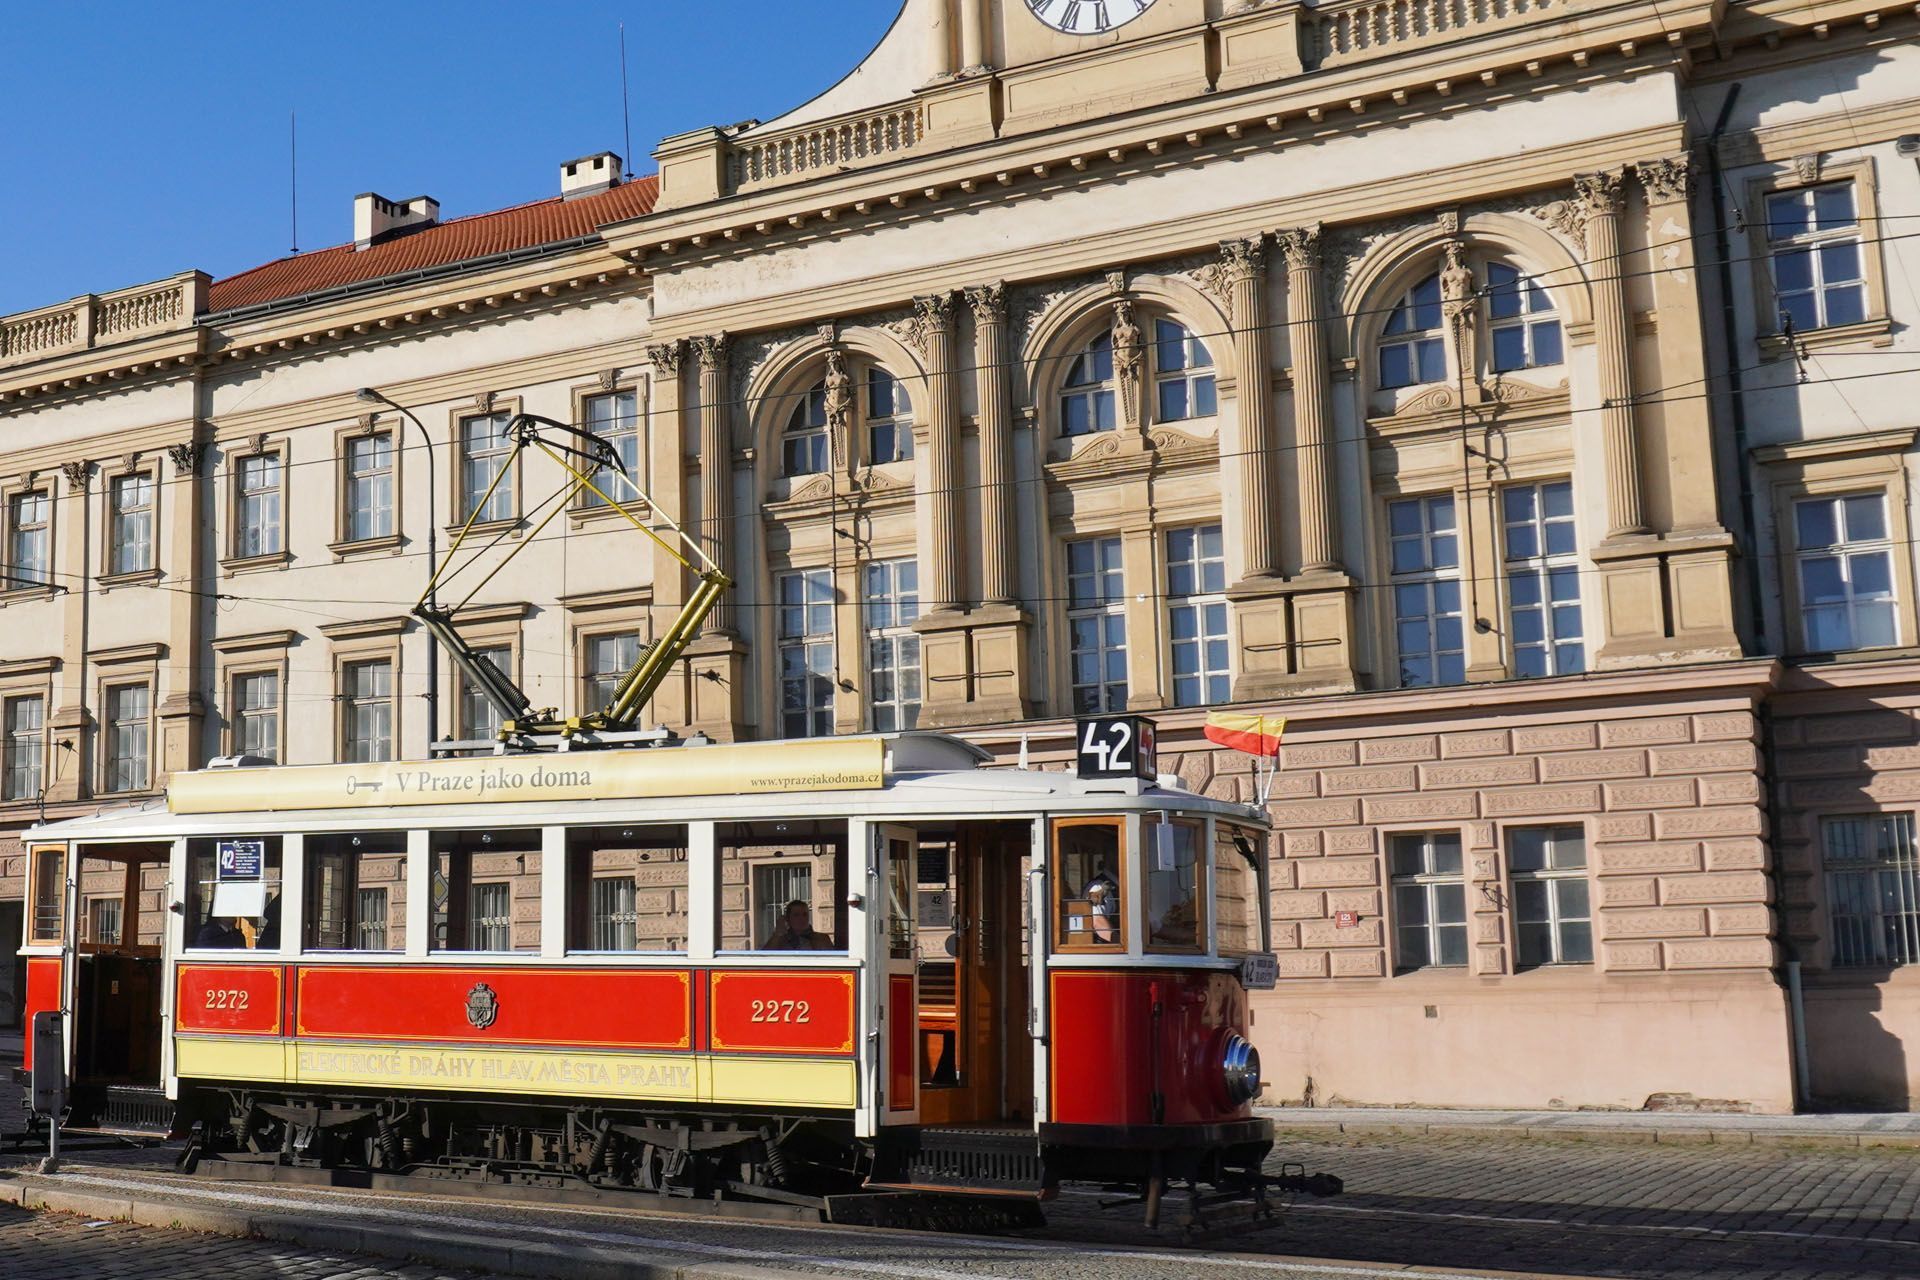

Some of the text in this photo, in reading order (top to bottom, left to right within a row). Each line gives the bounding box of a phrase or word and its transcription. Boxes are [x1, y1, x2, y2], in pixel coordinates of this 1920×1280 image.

[1081, 722, 1131, 770] 42
[396, 765, 592, 796] V Praze jako doma
[750, 773, 880, 788] www.vprazejakodoma.cz
[221, 850, 234, 869] 42
[932, 896, 942, 904] 42
[205, 989, 249, 1009] 2272
[751, 999, 810, 1023] 2272
[300, 1050, 400, 1075] ELEKTRICKÉ
[409, 1052, 475, 1078] DRÁHY
[537, 1059, 611, 1085] MĚSTA
